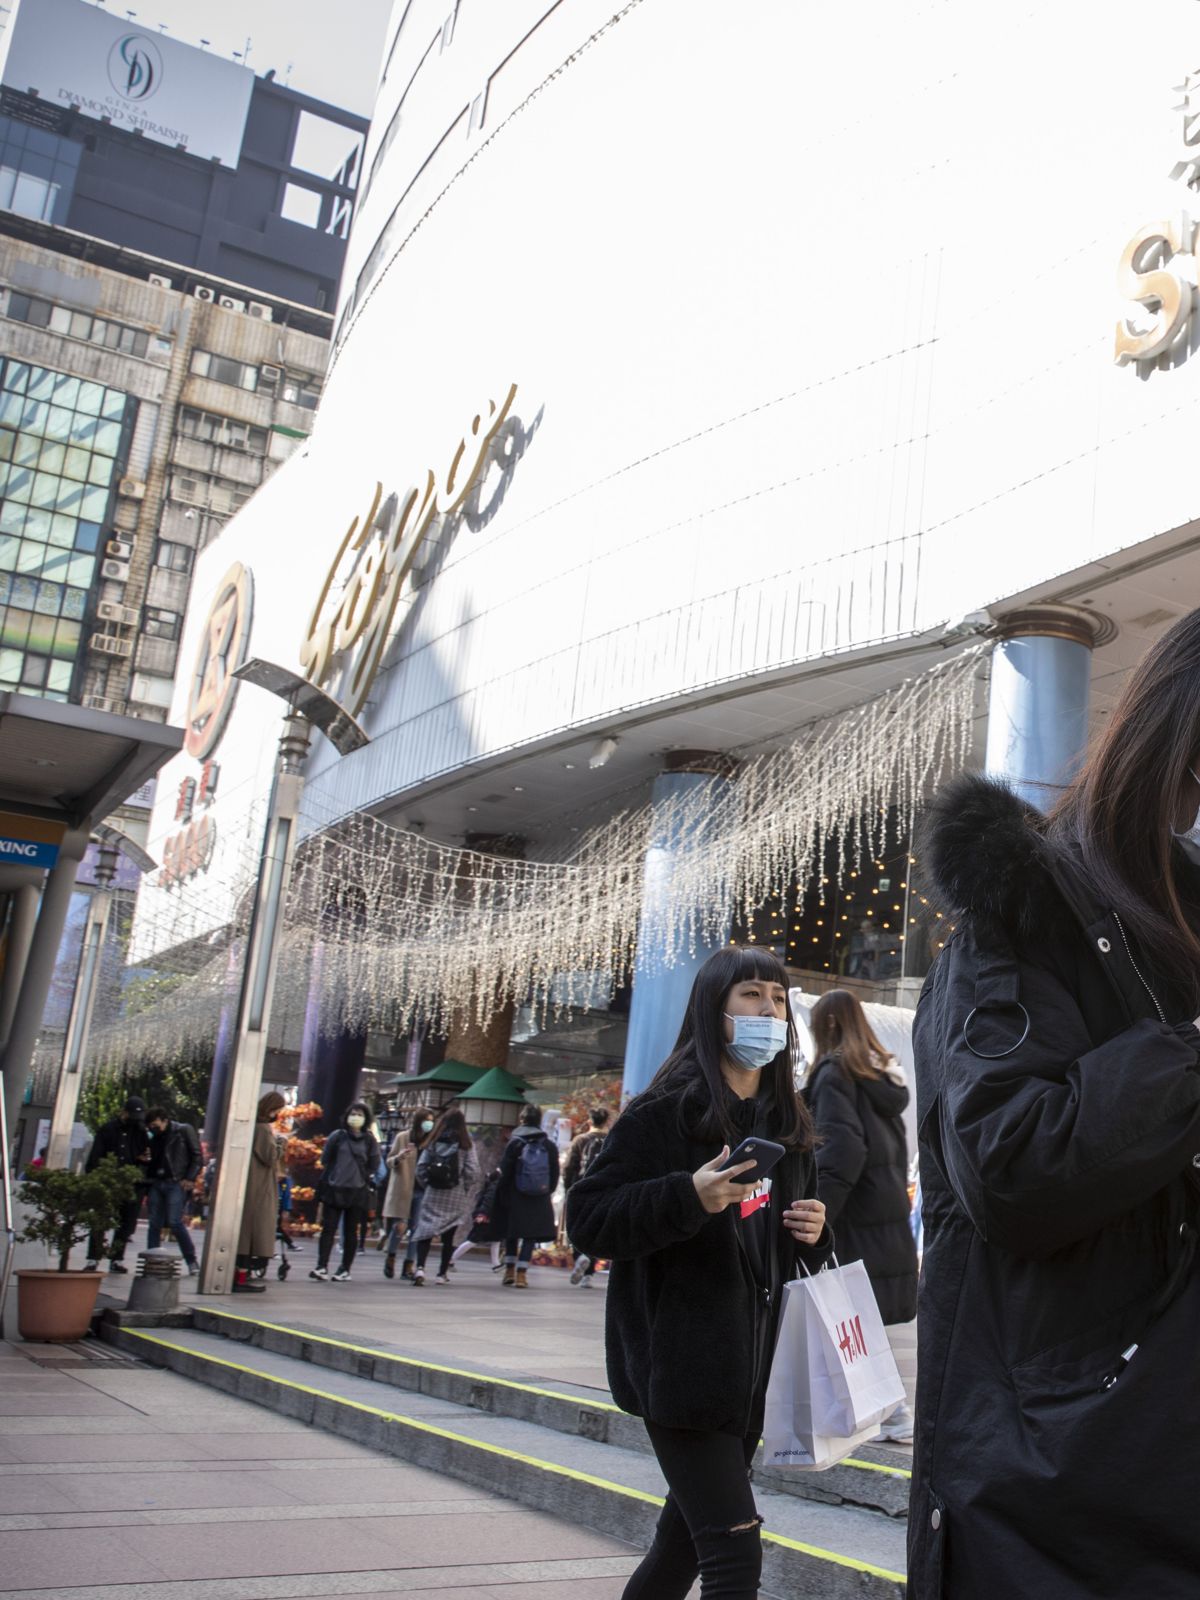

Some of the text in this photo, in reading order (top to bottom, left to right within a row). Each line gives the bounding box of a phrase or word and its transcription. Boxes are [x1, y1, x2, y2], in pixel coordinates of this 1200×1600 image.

[58, 87, 124, 120] DIAMOND
[127, 114, 190, 143] SHIRAISHI
[105, 96, 148, 117] GINZA
[835, 1314, 868, 1364] H&M
